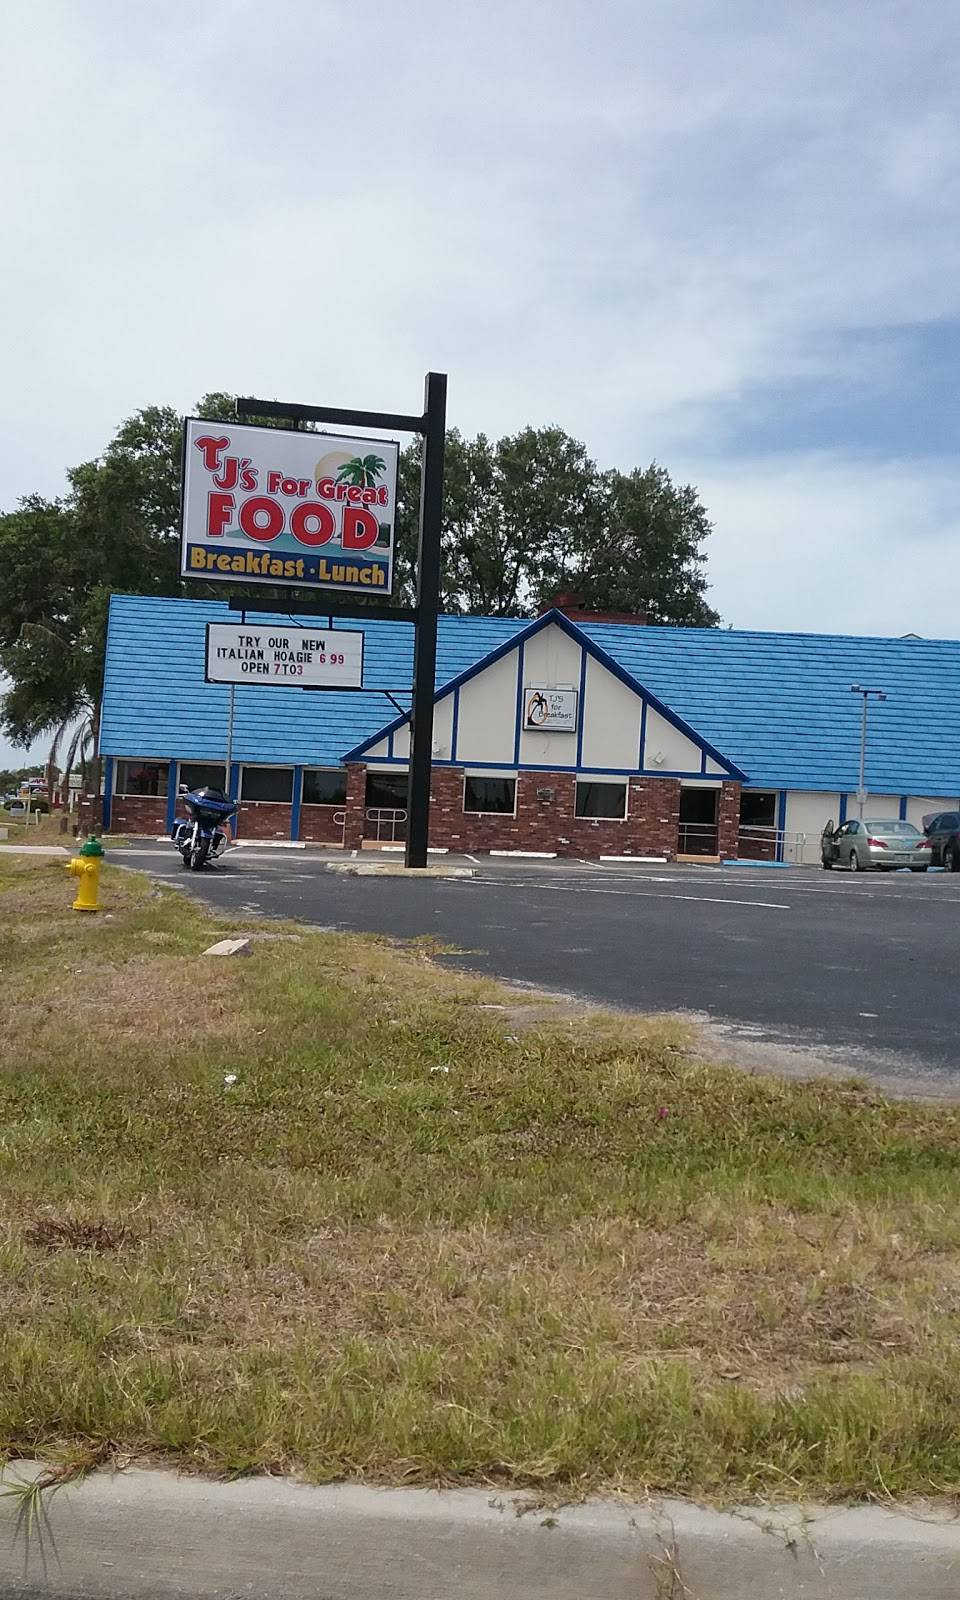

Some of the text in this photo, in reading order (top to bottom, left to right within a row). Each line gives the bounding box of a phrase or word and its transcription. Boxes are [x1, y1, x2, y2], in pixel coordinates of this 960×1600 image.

[267, 471, 311, 498] For
[316, 476, 389, 507] Great
[206, 491, 379, 550] FOOD
[191, 547, 385, 586] Breakfast Lunch
[217, 647, 264, 660] ITALIAN
[274, 651, 313, 663] HOAGIE
[238, 635, 326, 651] TRY OUR NEW
[241, 661, 269, 674] OPEN
